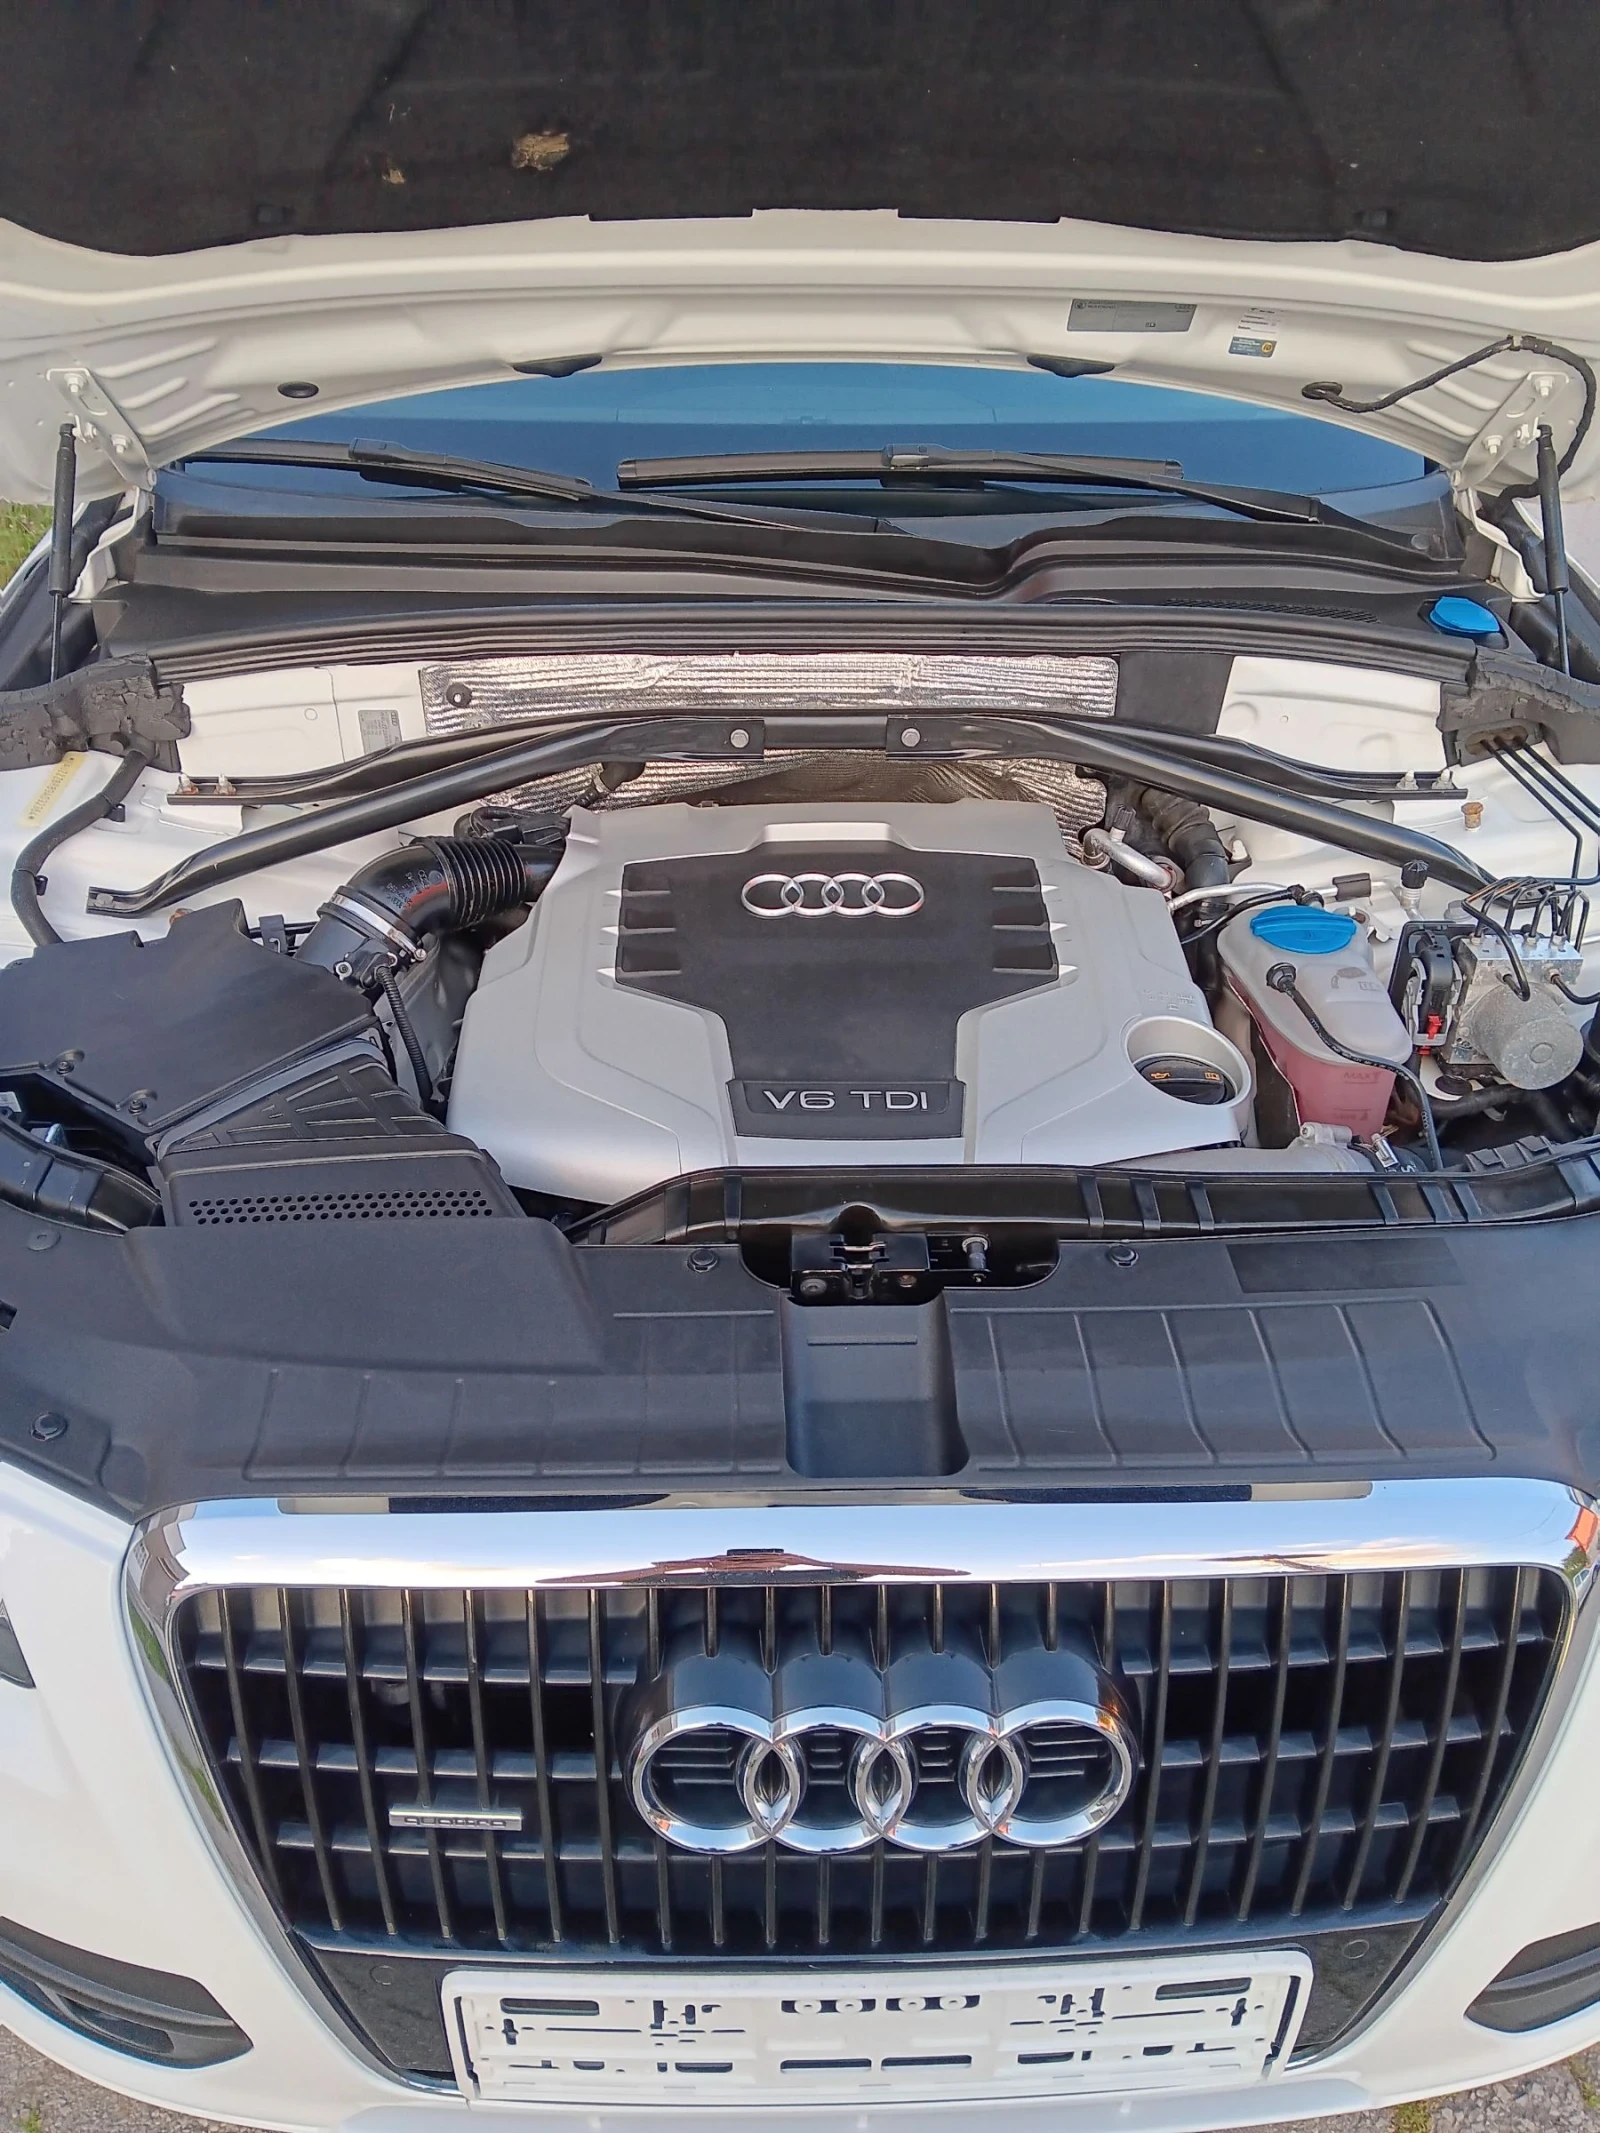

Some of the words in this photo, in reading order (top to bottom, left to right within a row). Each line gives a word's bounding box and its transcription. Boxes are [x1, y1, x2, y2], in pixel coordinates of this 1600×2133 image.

[763, 1090, 836, 1109] V6
[849, 1090, 928, 1109] TDI
[404, 1815, 507, 1827] quattro
